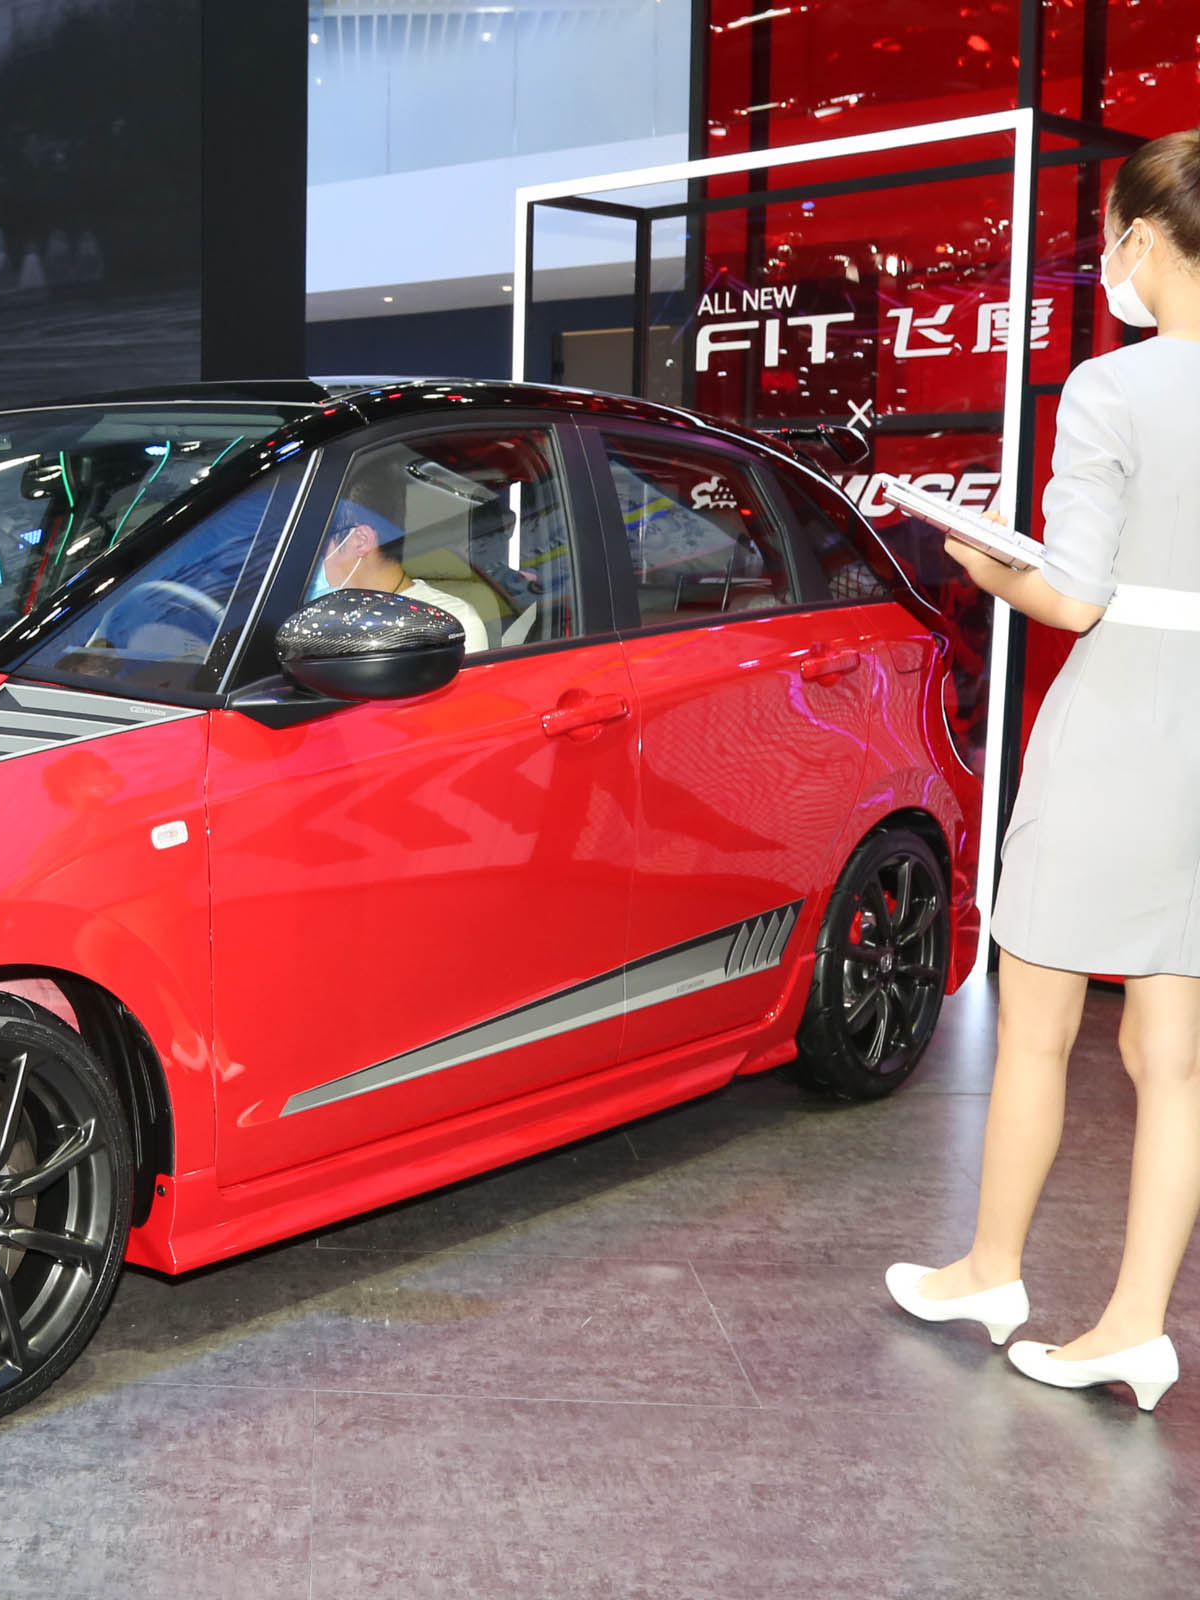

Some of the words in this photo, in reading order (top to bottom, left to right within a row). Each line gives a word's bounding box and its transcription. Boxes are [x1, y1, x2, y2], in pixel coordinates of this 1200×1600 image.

[697, 291, 736, 316] ALL
[742, 285, 797, 312] NEW
[695, 312, 855, 372] FIT
[886, 297, 1054, 358] 飞度
